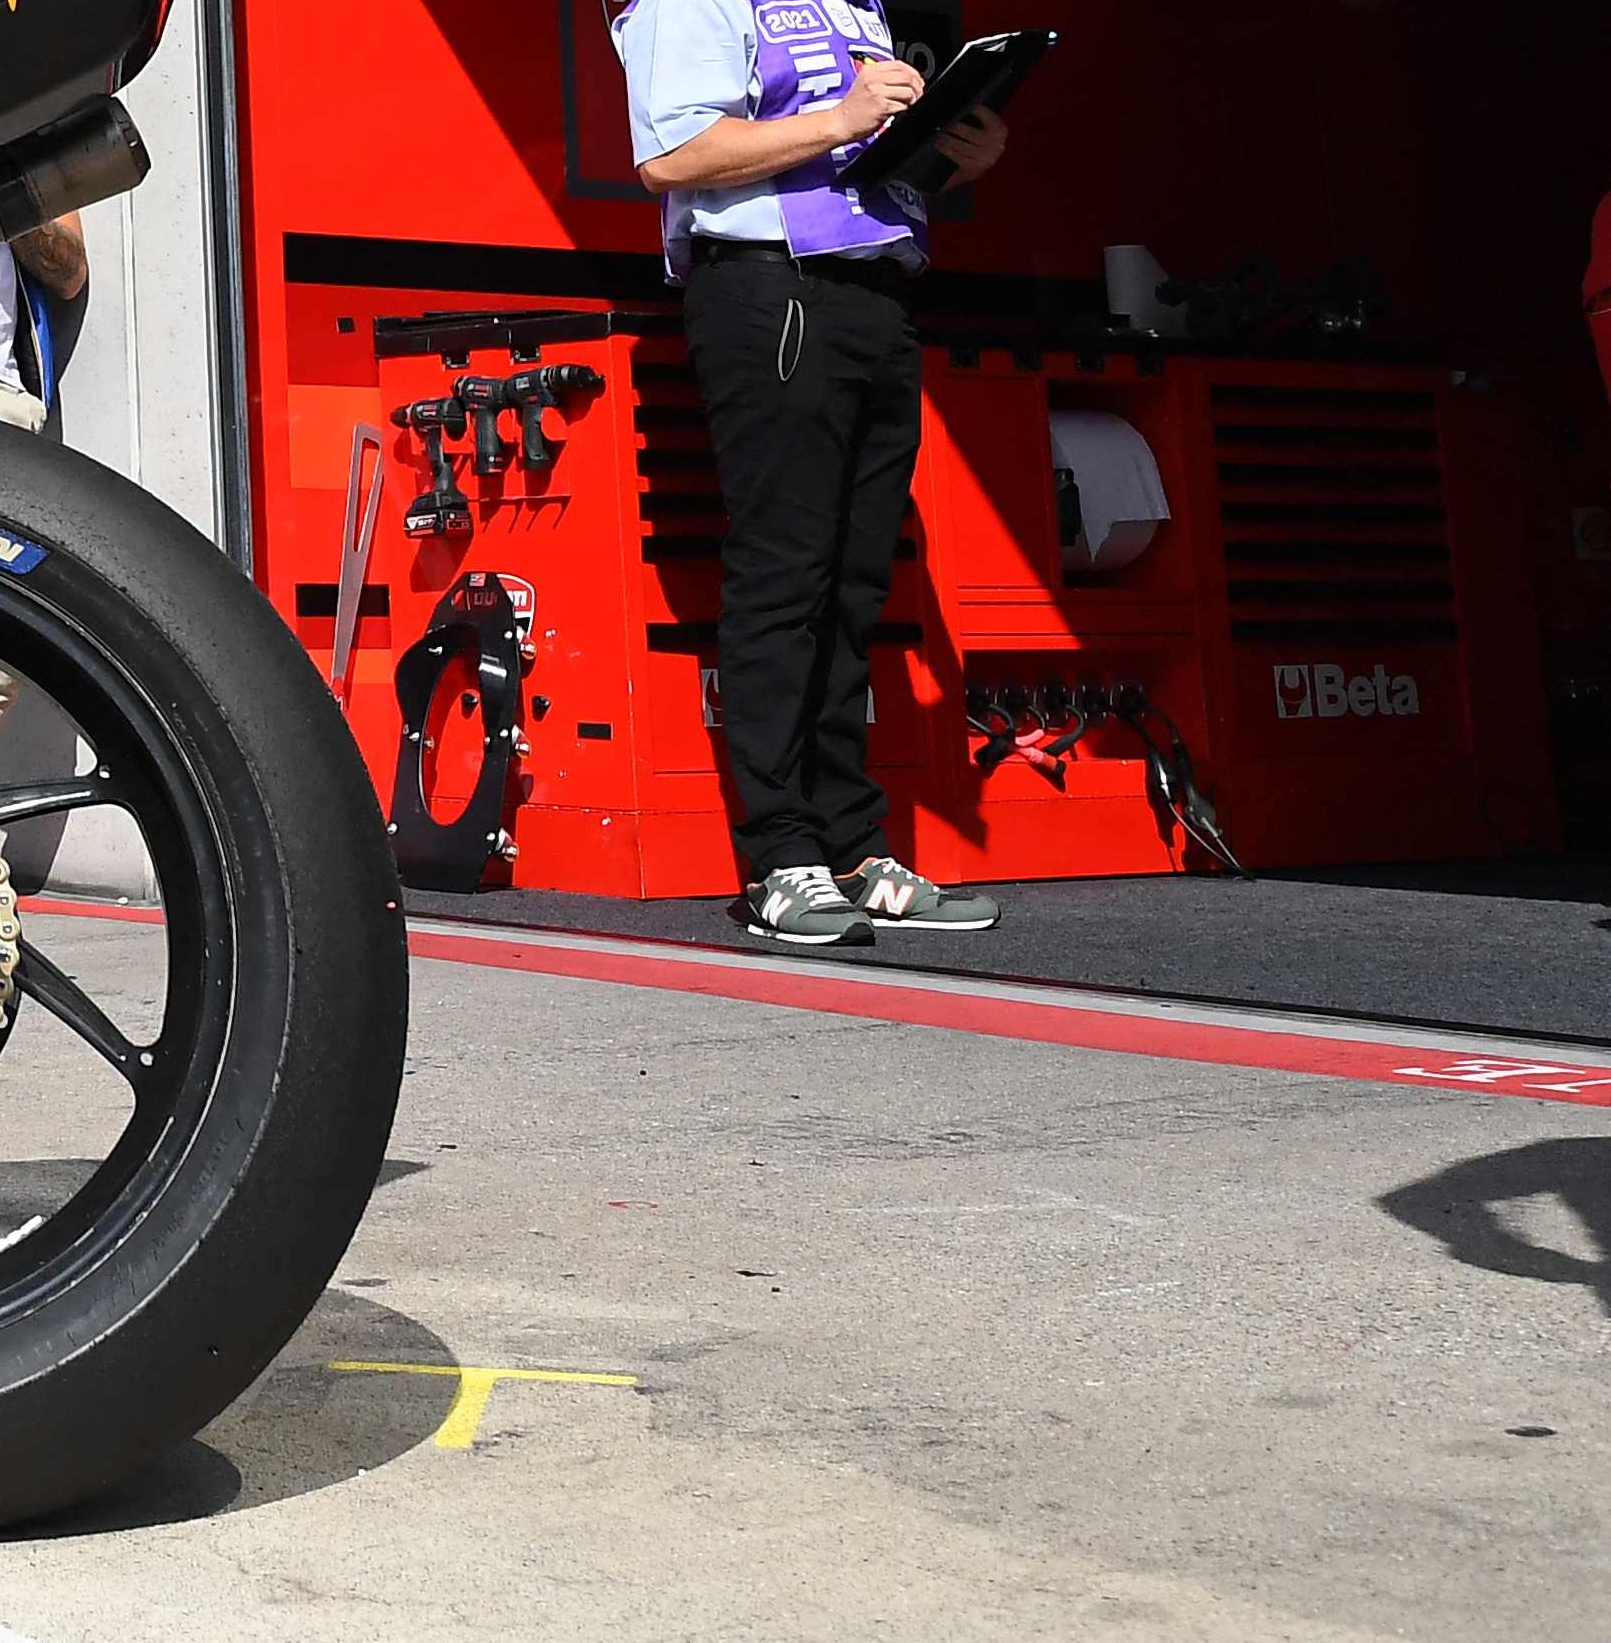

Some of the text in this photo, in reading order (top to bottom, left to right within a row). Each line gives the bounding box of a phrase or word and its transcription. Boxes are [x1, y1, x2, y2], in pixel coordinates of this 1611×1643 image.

[765, 9, 821, 34] 2021
[1314, 664, 1420, 717] Beta
[865, 878, 915, 916] N
